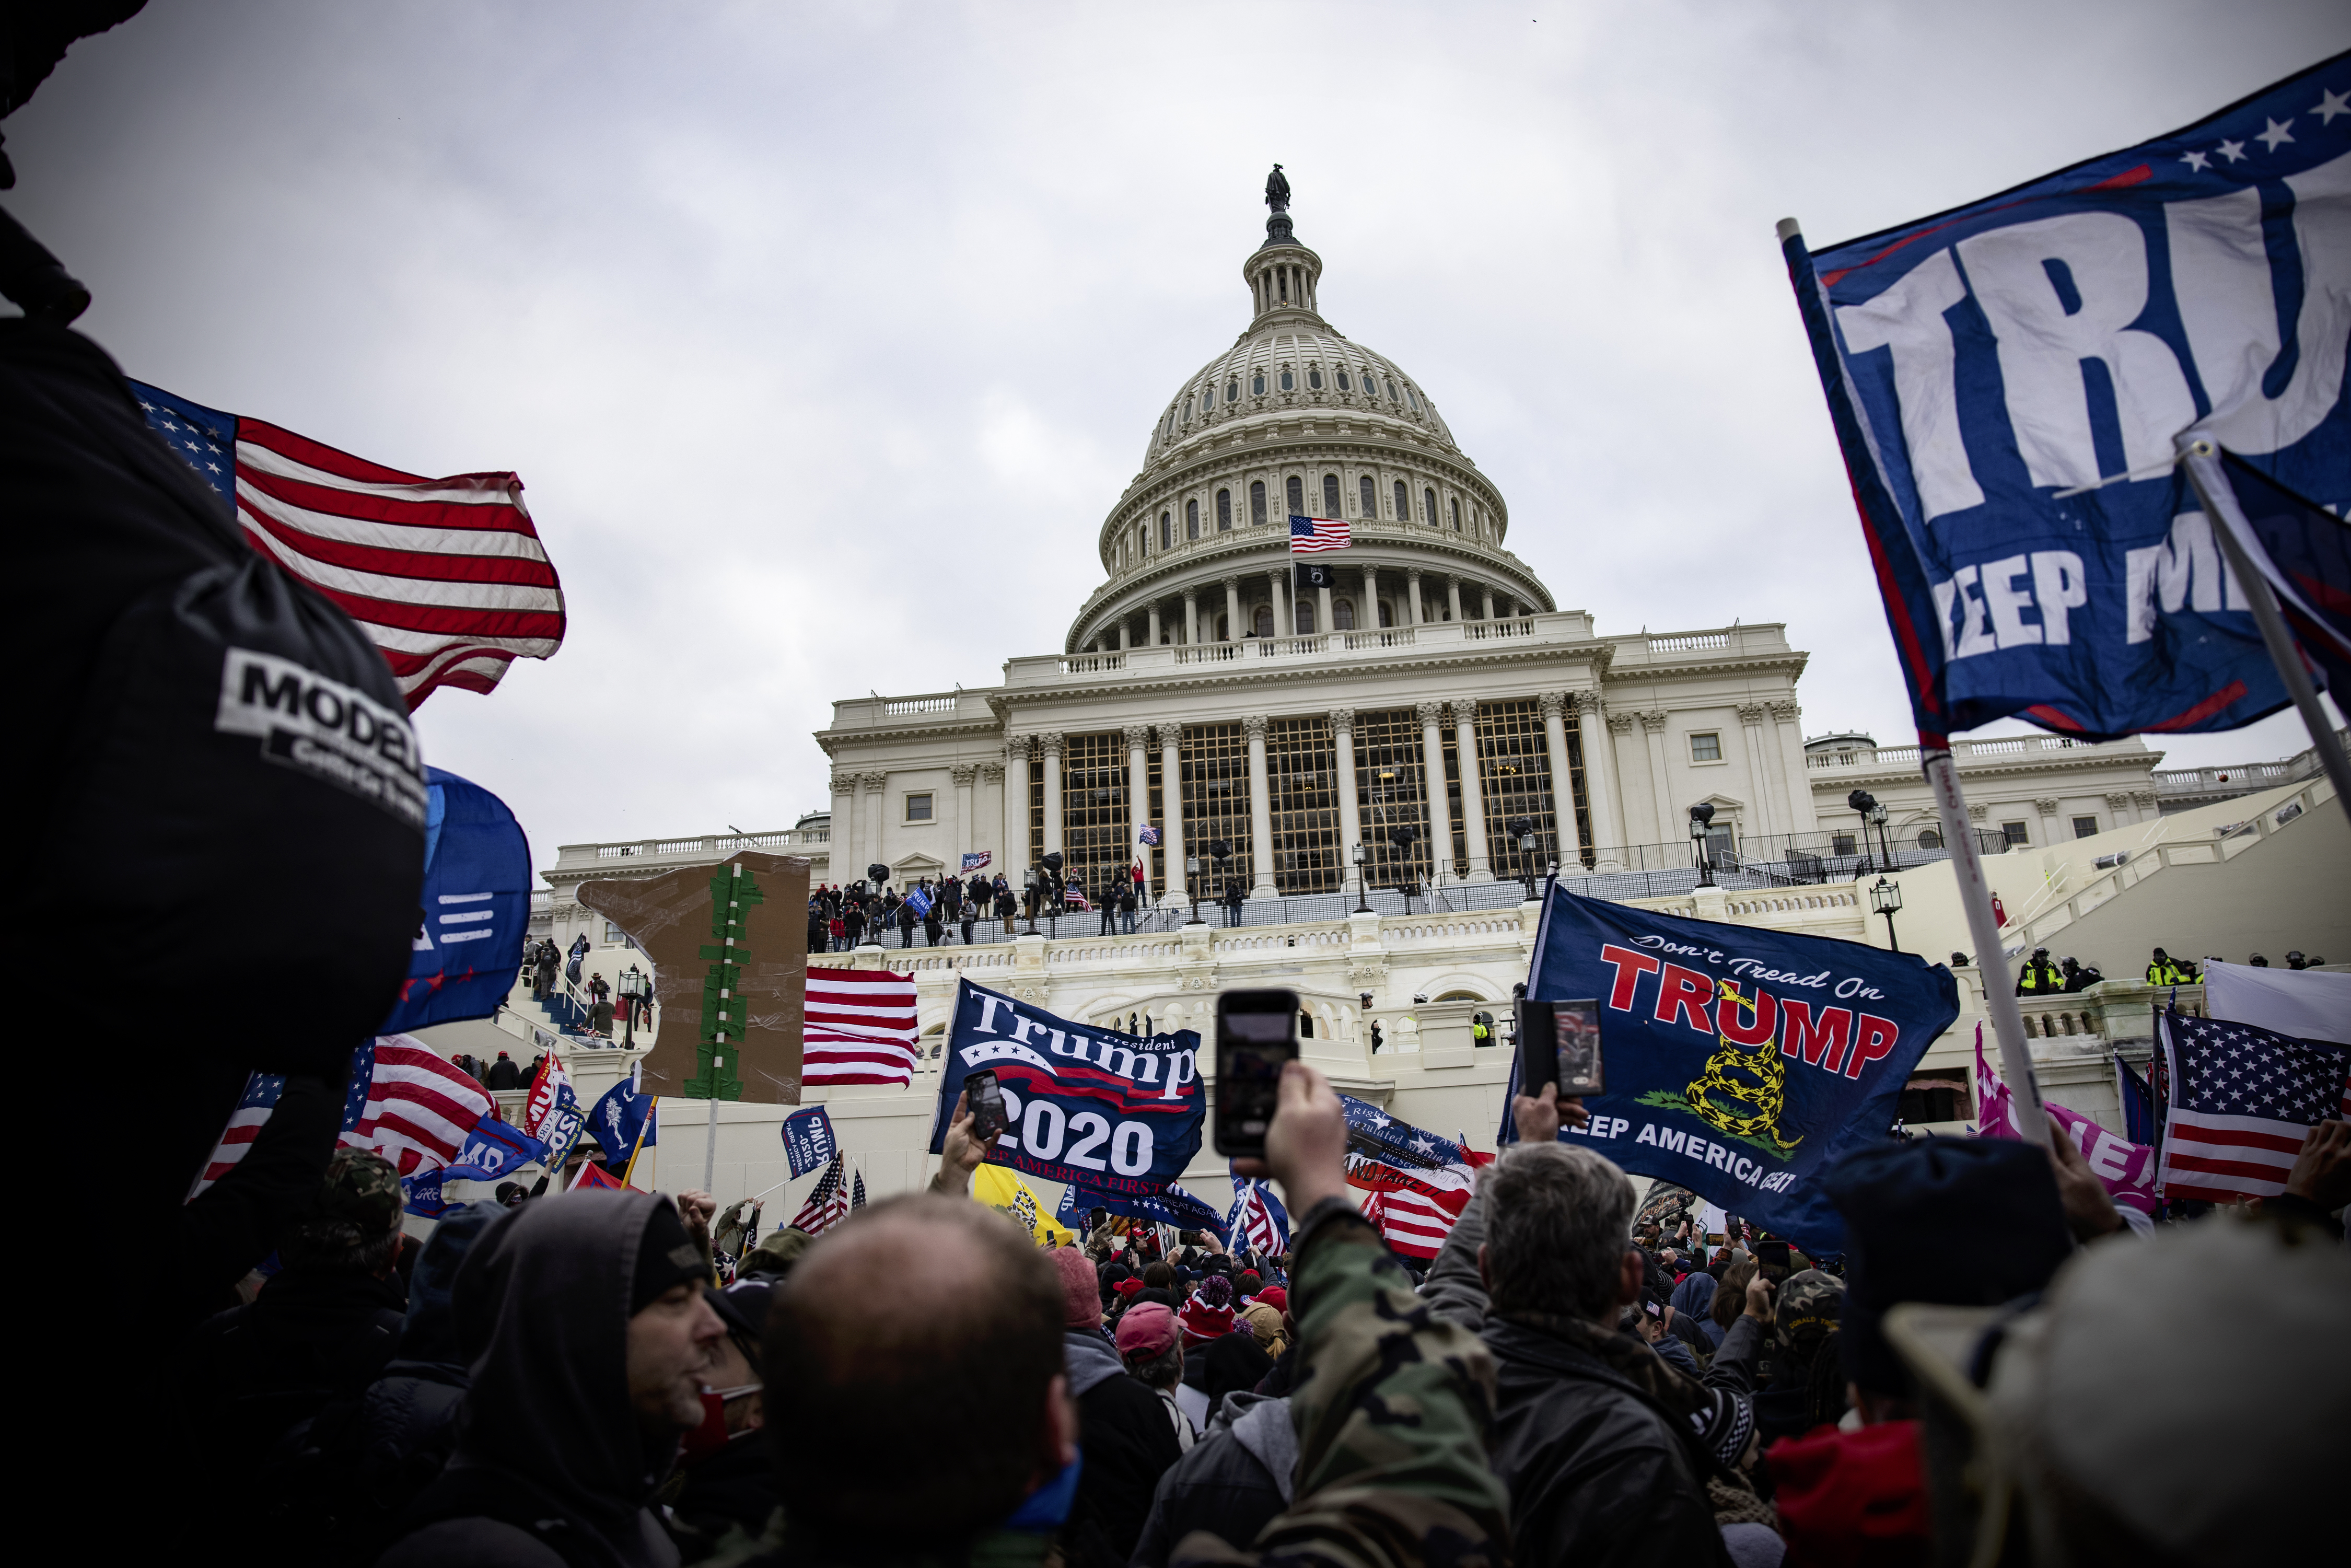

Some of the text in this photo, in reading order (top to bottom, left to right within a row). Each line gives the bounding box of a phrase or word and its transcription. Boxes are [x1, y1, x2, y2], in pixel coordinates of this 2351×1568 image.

[1630, 935, 1884, 1001] Don't Tread On
[1600, 943, 1900, 1081] TRUMP
[969, 989, 1195, 1099] Trump
[1102, 1034, 1176, 1051] President
[997, 1087, 1154, 1177] 2020
[1353, 1107, 1387, 1119] Right
[1438, 1137, 1470, 1157] Arms.
[1014, 1155, 1102, 1186] AMERICA
[1446, 1156, 1474, 1178] being
[1636, 1123, 1762, 1188] AMERICA
[1379, 1166, 1423, 1191] TAKE
[1422, 1185, 1447, 1198] IT
[1158, 1195, 1189, 1211] GREAT
[1789, 1316, 1817, 1330] DONALD
